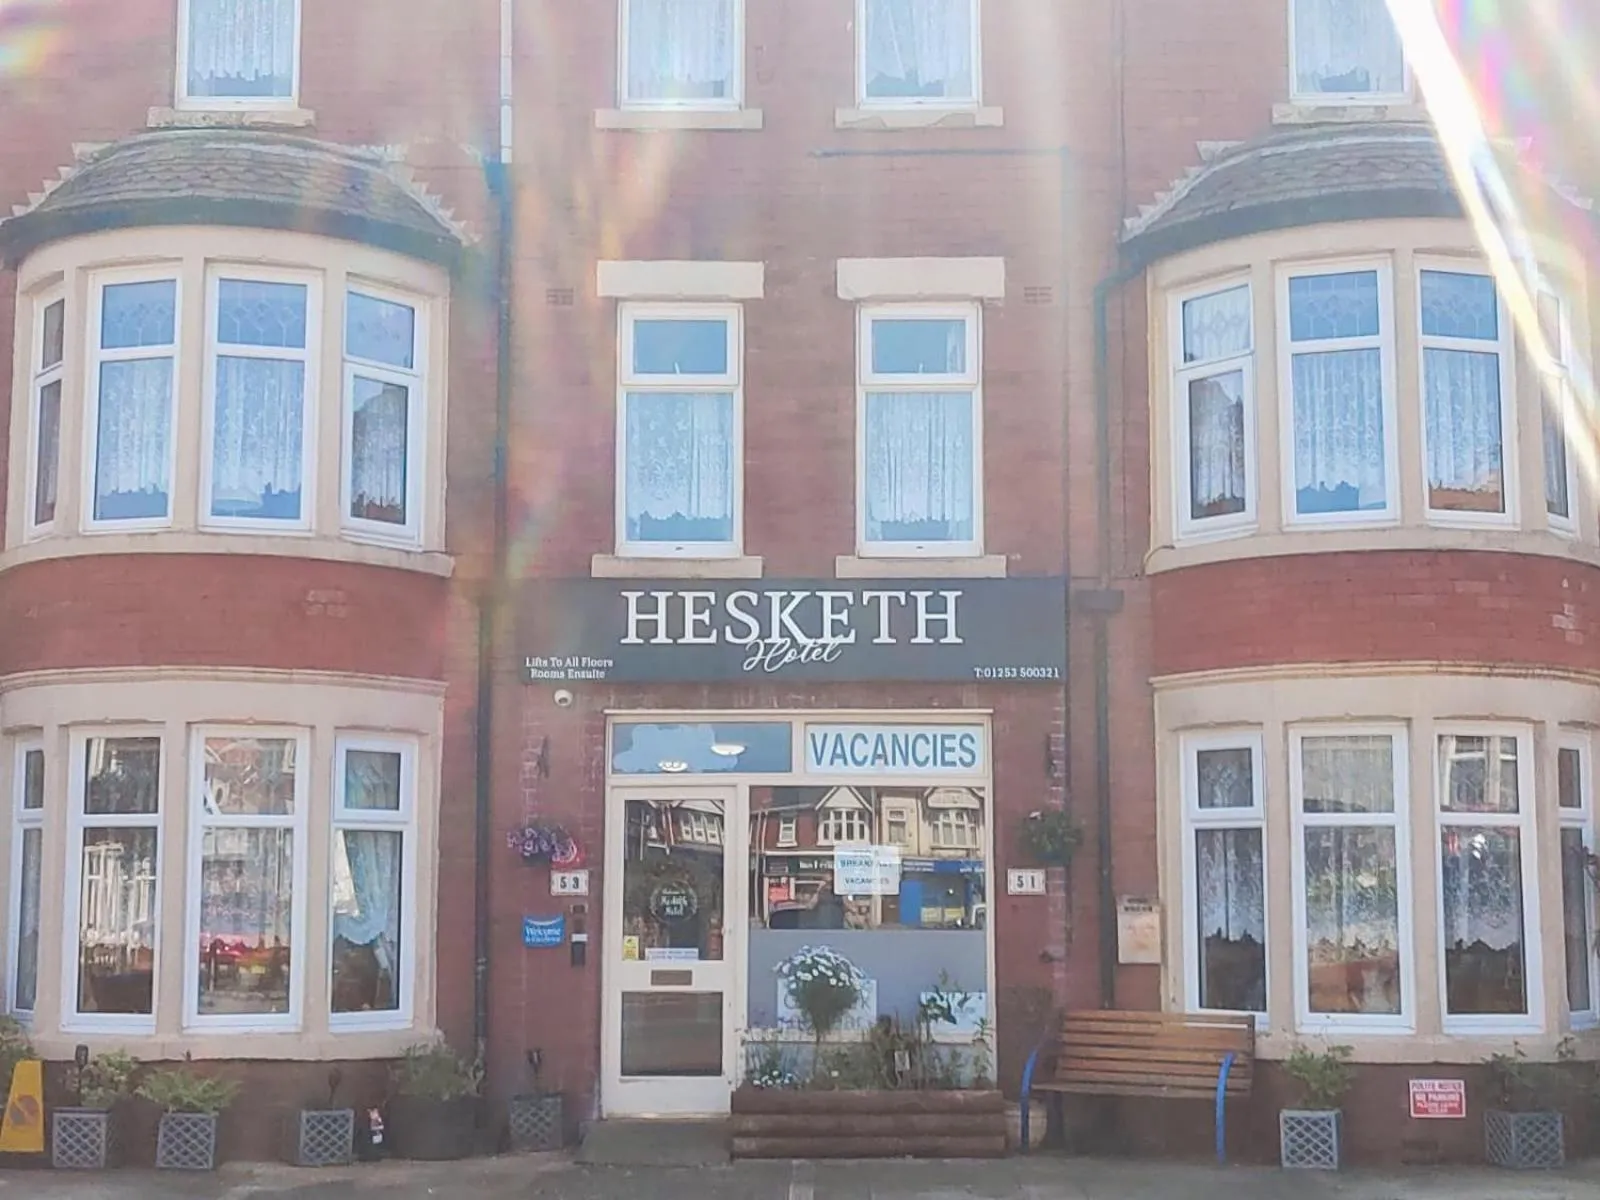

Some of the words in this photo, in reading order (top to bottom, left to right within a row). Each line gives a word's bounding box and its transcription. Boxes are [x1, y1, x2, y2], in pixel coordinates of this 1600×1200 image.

[620, 590, 964, 644] HESKETH
[743, 635, 842, 673] Hotel
[526, 656, 548, 668] Lifts
[549, 656, 563, 668] To
[564, 656, 579, 668] All
[581, 656, 614, 668] Floors
[530, 668, 565, 679] Rooms
[567, 668, 606, 679] Ensuite
[1020, 667, 1059, 679] 500321
[810, 732, 976, 769] VACANCIES
[560, 876, 580, 889] 53
[1017, 875, 1035, 888] 51
